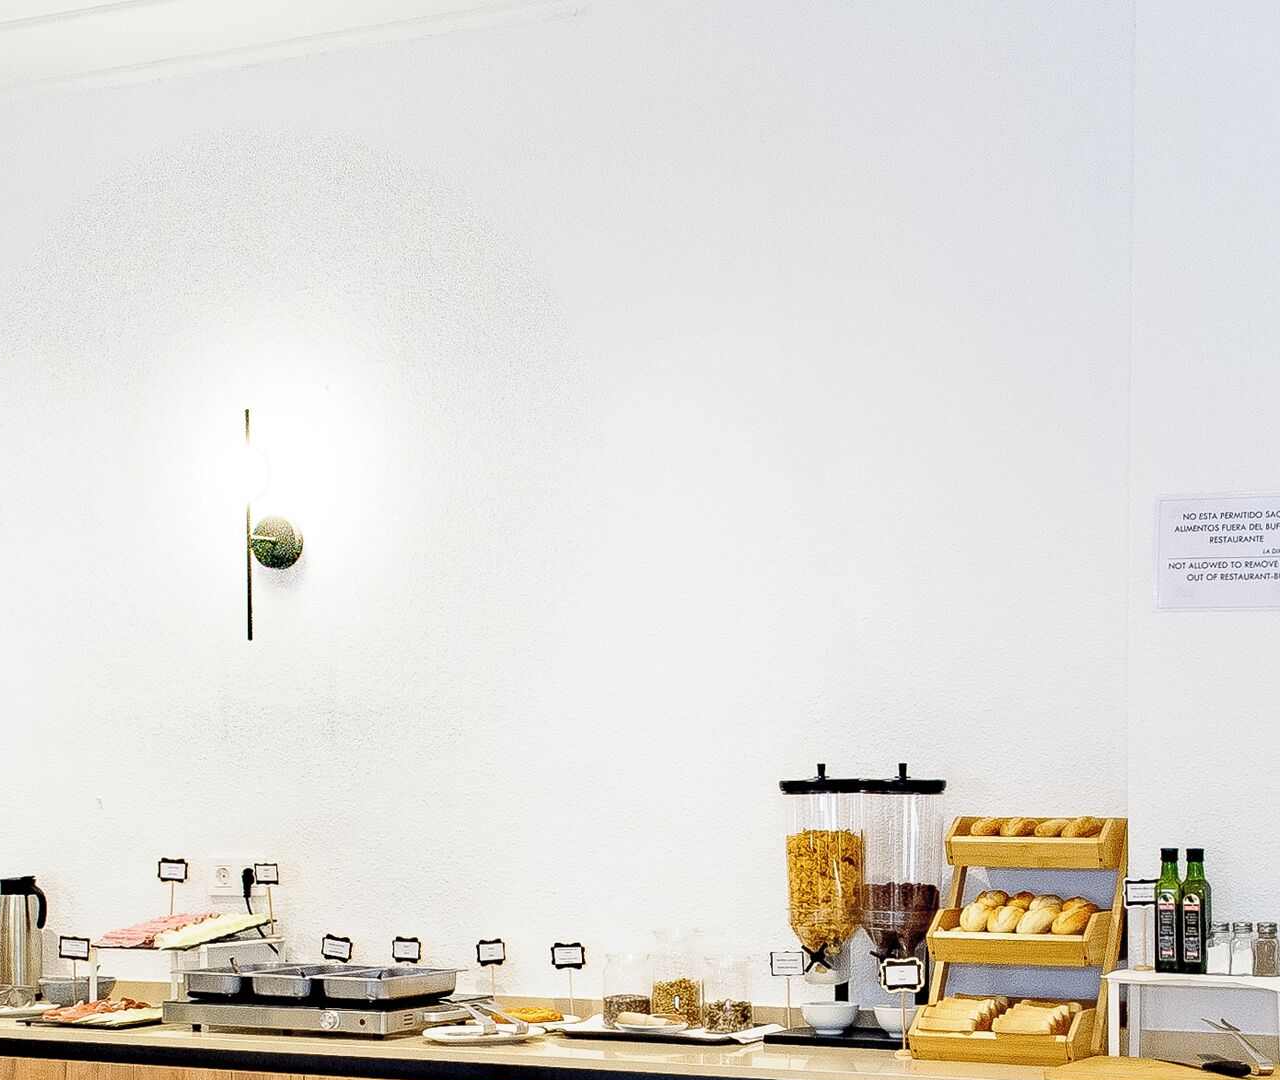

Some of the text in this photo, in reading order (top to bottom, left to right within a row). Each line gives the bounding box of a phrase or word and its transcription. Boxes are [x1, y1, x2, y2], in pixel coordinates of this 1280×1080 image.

[1182, 513, 1197, 521] NO
[1199, 512, 1218, 520] ESTA
[1220, 511, 1263, 519] PERMITIDO
[1174, 524, 1220, 533] ALIMENTOS
[1249, 523, 1263, 531] DEL
[1209, 535, 1264, 544] RESTAURANTE
[1168, 562, 1186, 570] NOT
[1188, 561, 1229, 569] ALLOWED
[1231, 561, 1242, 569] TO
[1244, 560, 1279, 568] REMOVE
[1186, 573, 1204, 581] OUT
[1206, 573, 1218, 581] OF
